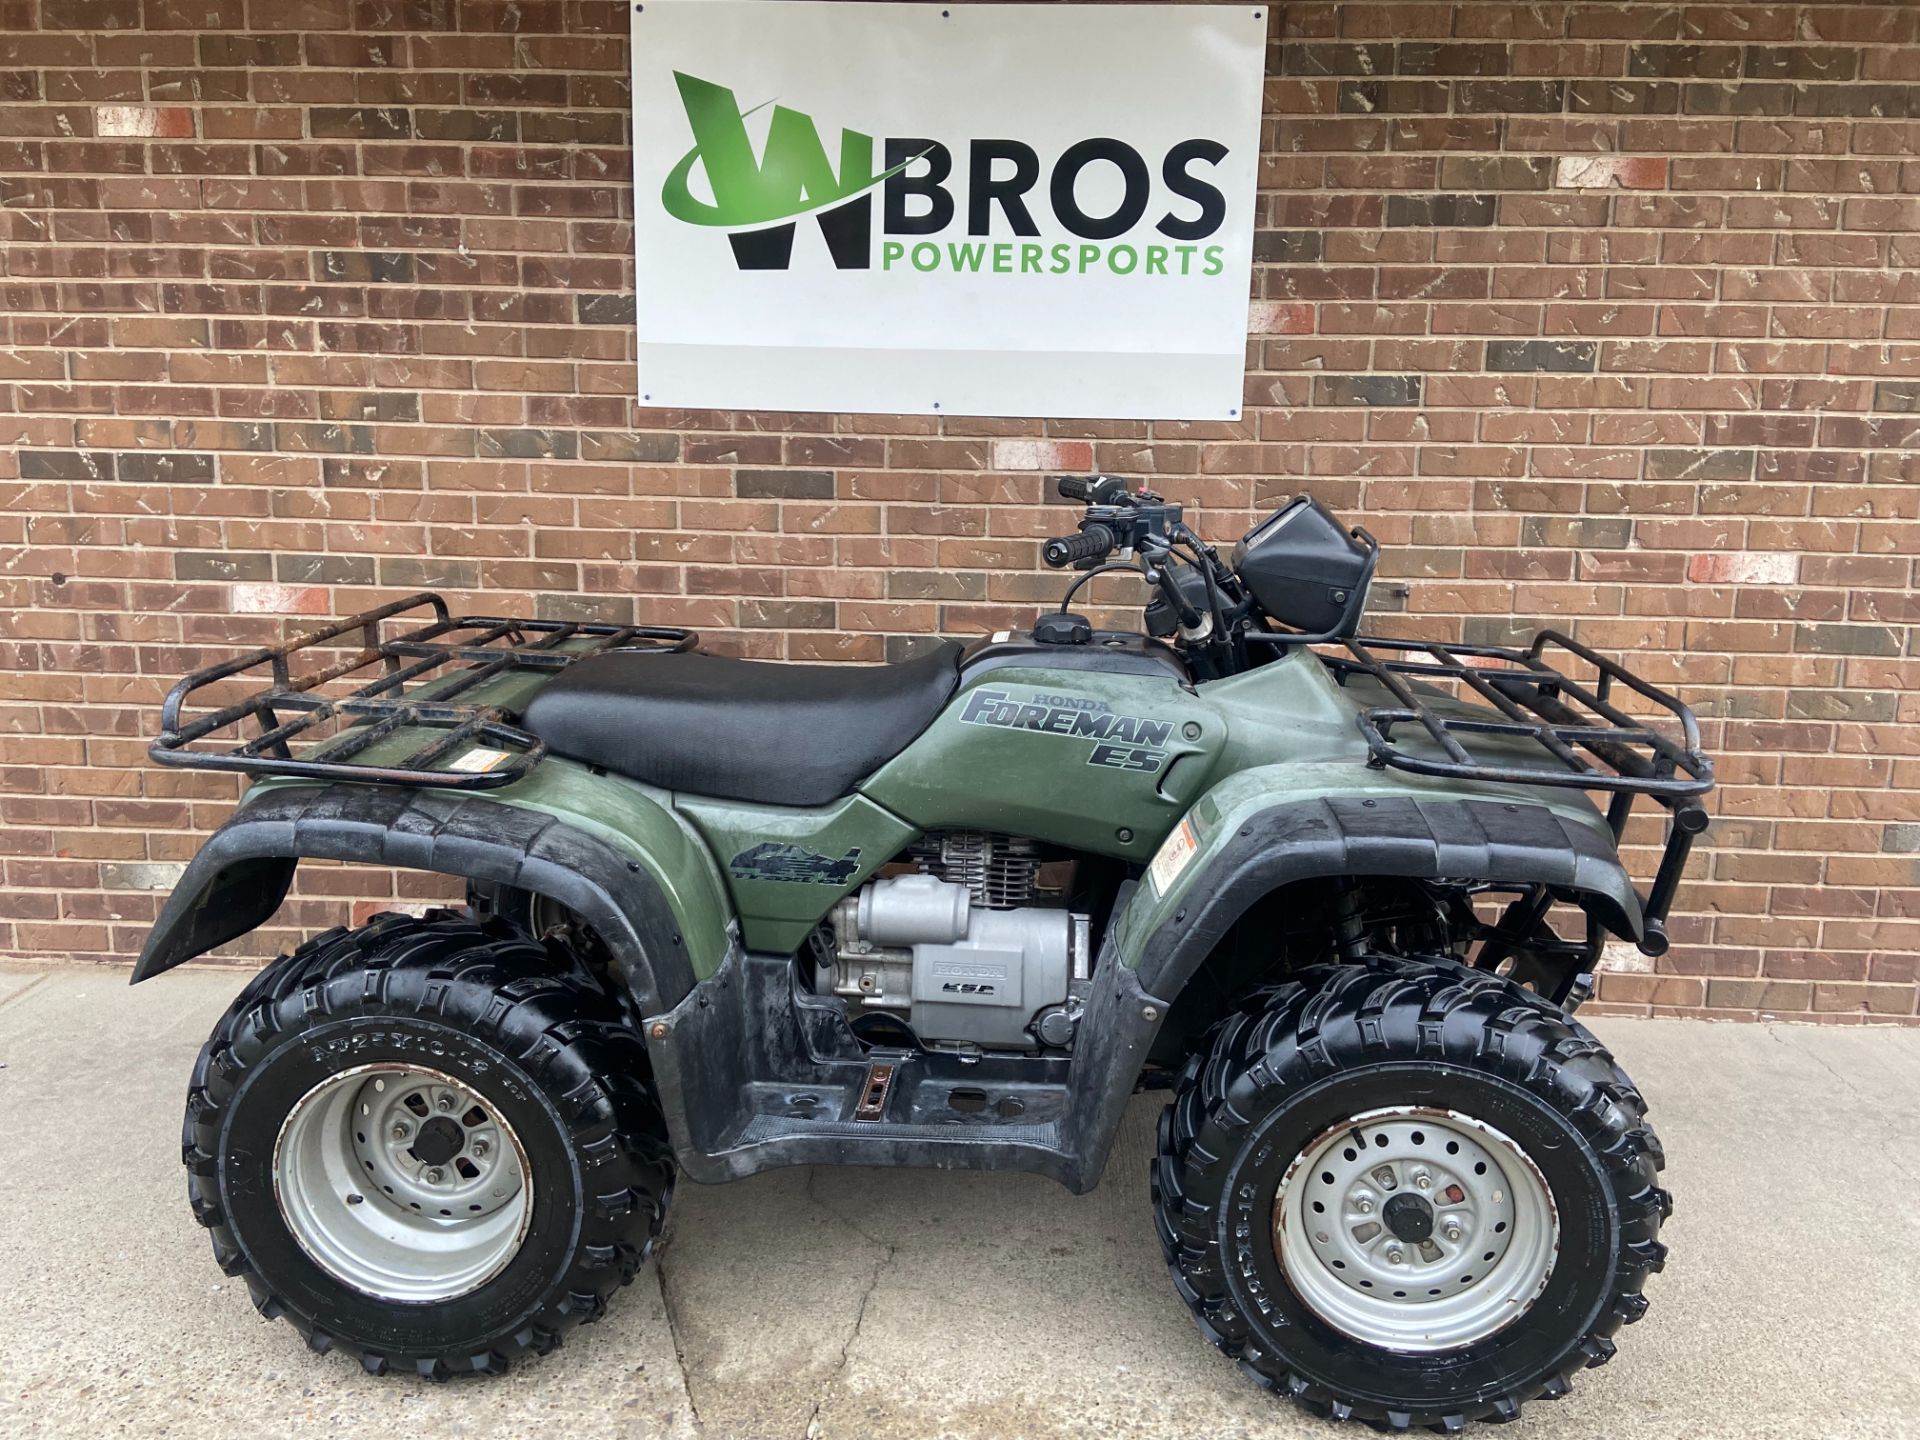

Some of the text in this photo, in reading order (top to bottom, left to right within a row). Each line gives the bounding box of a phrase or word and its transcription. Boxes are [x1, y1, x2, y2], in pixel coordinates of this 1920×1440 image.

[884, 138, 1230, 241] BROS
[883, 242, 1225, 276] POWERSPORTS
[959, 689, 1175, 748] FOREMAN
[1033, 693, 1113, 713] HONDA
[1087, 744, 1168, 773] ES
[935, 965, 1006, 978] HONDA
